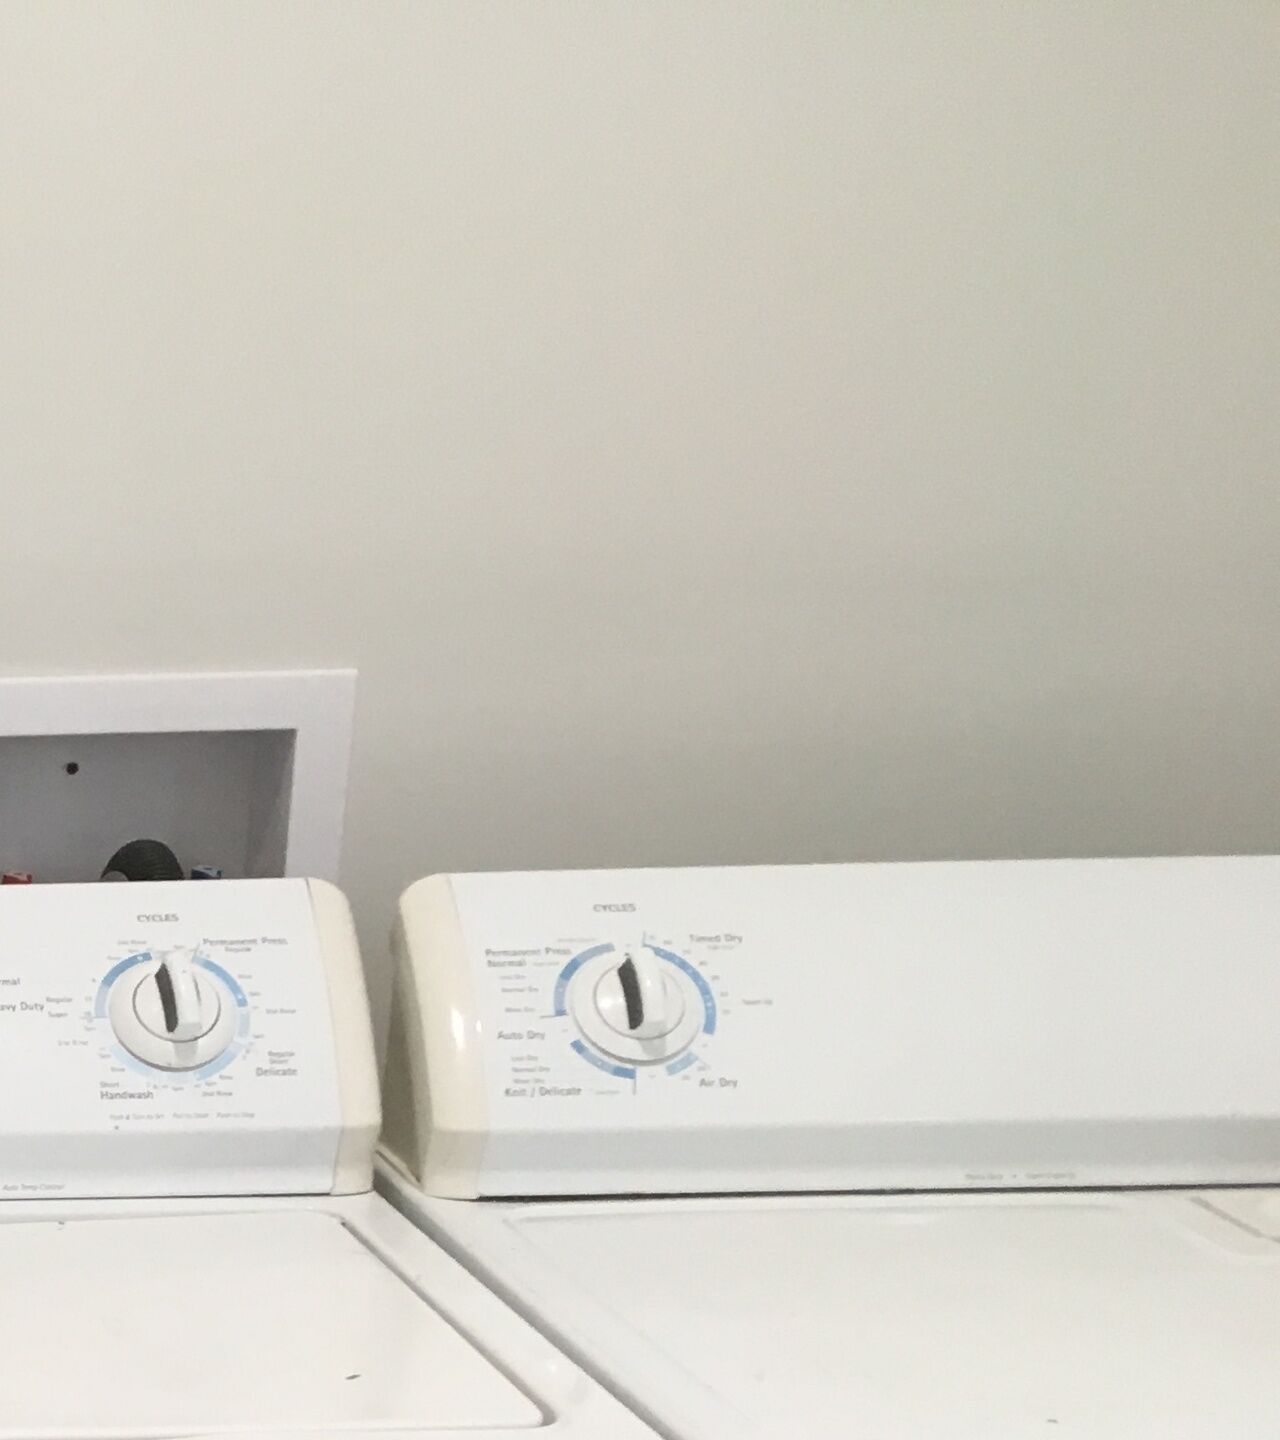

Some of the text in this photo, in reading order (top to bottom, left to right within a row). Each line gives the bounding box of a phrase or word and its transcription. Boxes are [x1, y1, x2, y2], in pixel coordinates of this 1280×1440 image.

[593, 904, 636, 912] CYCLES
[137, 914, 179, 922] CYCLES
[202, 938, 257, 946] Permanent
[724, 934, 743, 943] Dry
[20, 1002, 44, 1011] Duty
[497, 1030, 545, 1040] Auto Dry
[256, 1067, 298, 1077] Delicate
[699, 1078, 715, 1087] Air
[718, 1077, 738, 1088] Dry
[100, 1091, 153, 1100] Handwash
[540, 1087, 582, 1096] Delicate
